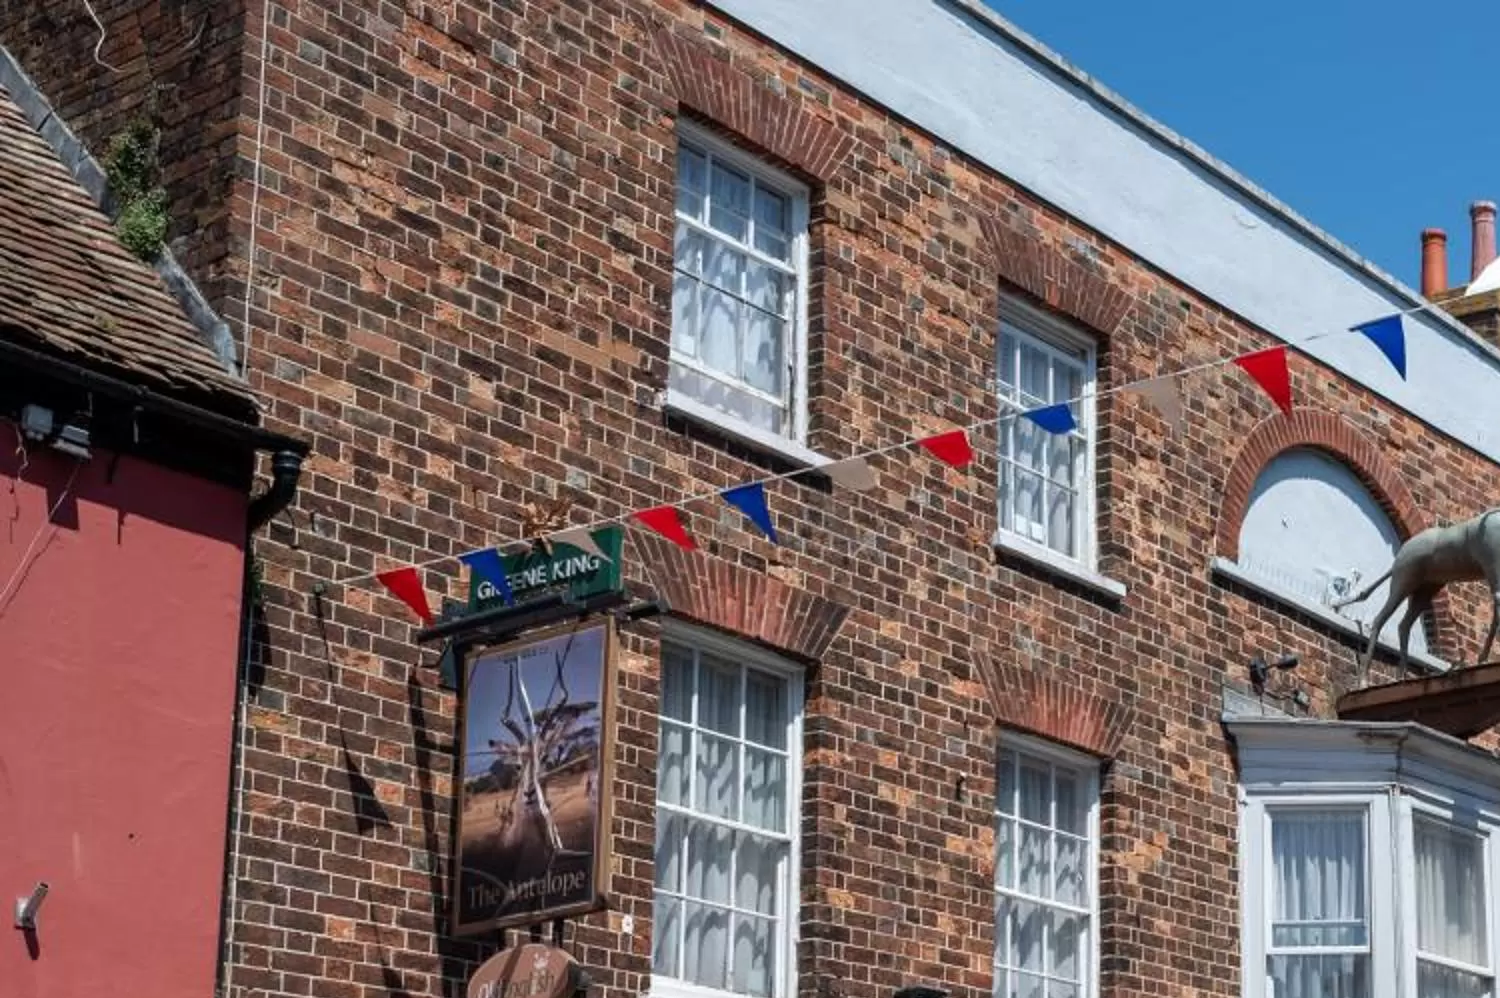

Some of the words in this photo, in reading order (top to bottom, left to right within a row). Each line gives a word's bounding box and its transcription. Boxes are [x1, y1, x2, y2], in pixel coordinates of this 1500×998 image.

[552, 554, 600, 580] KING
[469, 883, 501, 909] The
[505, 868, 586, 901] Antelope
